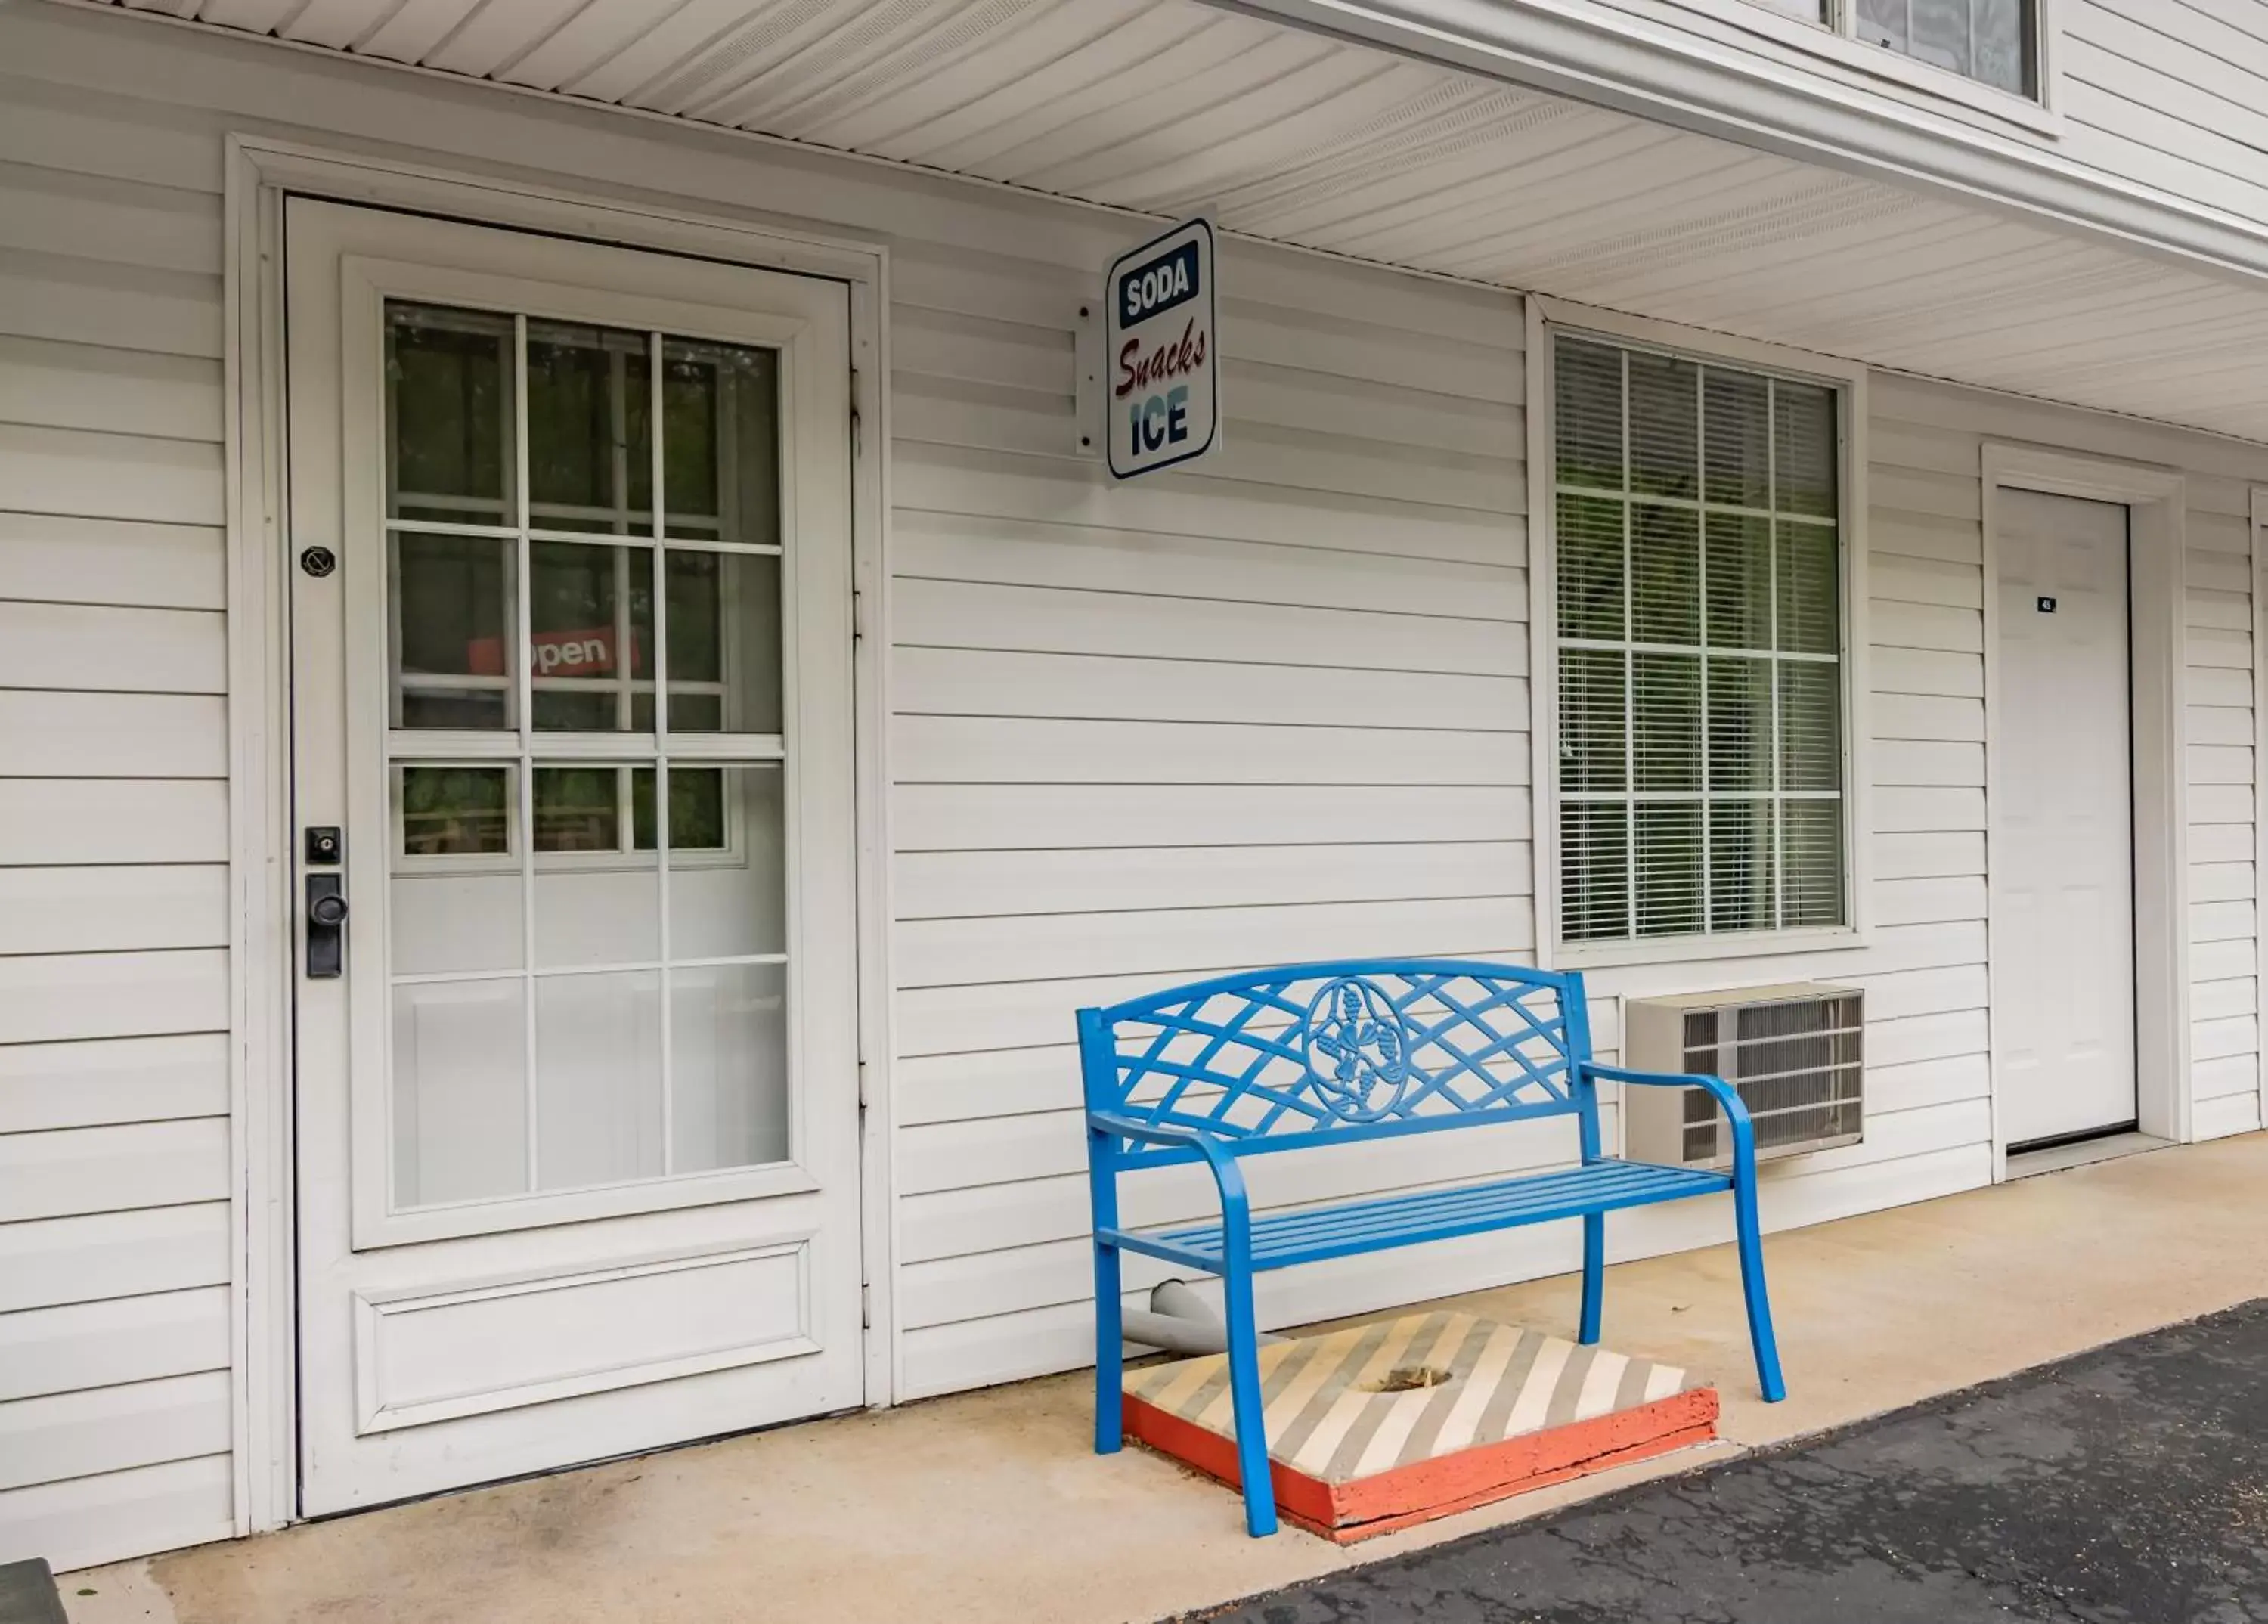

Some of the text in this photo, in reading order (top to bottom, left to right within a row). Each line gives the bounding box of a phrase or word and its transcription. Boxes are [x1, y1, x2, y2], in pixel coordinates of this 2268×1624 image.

[1127, 257, 1189, 316] SODA
[1115, 316, 1206, 398] Snacks
[1129, 386, 1189, 456] ICE
